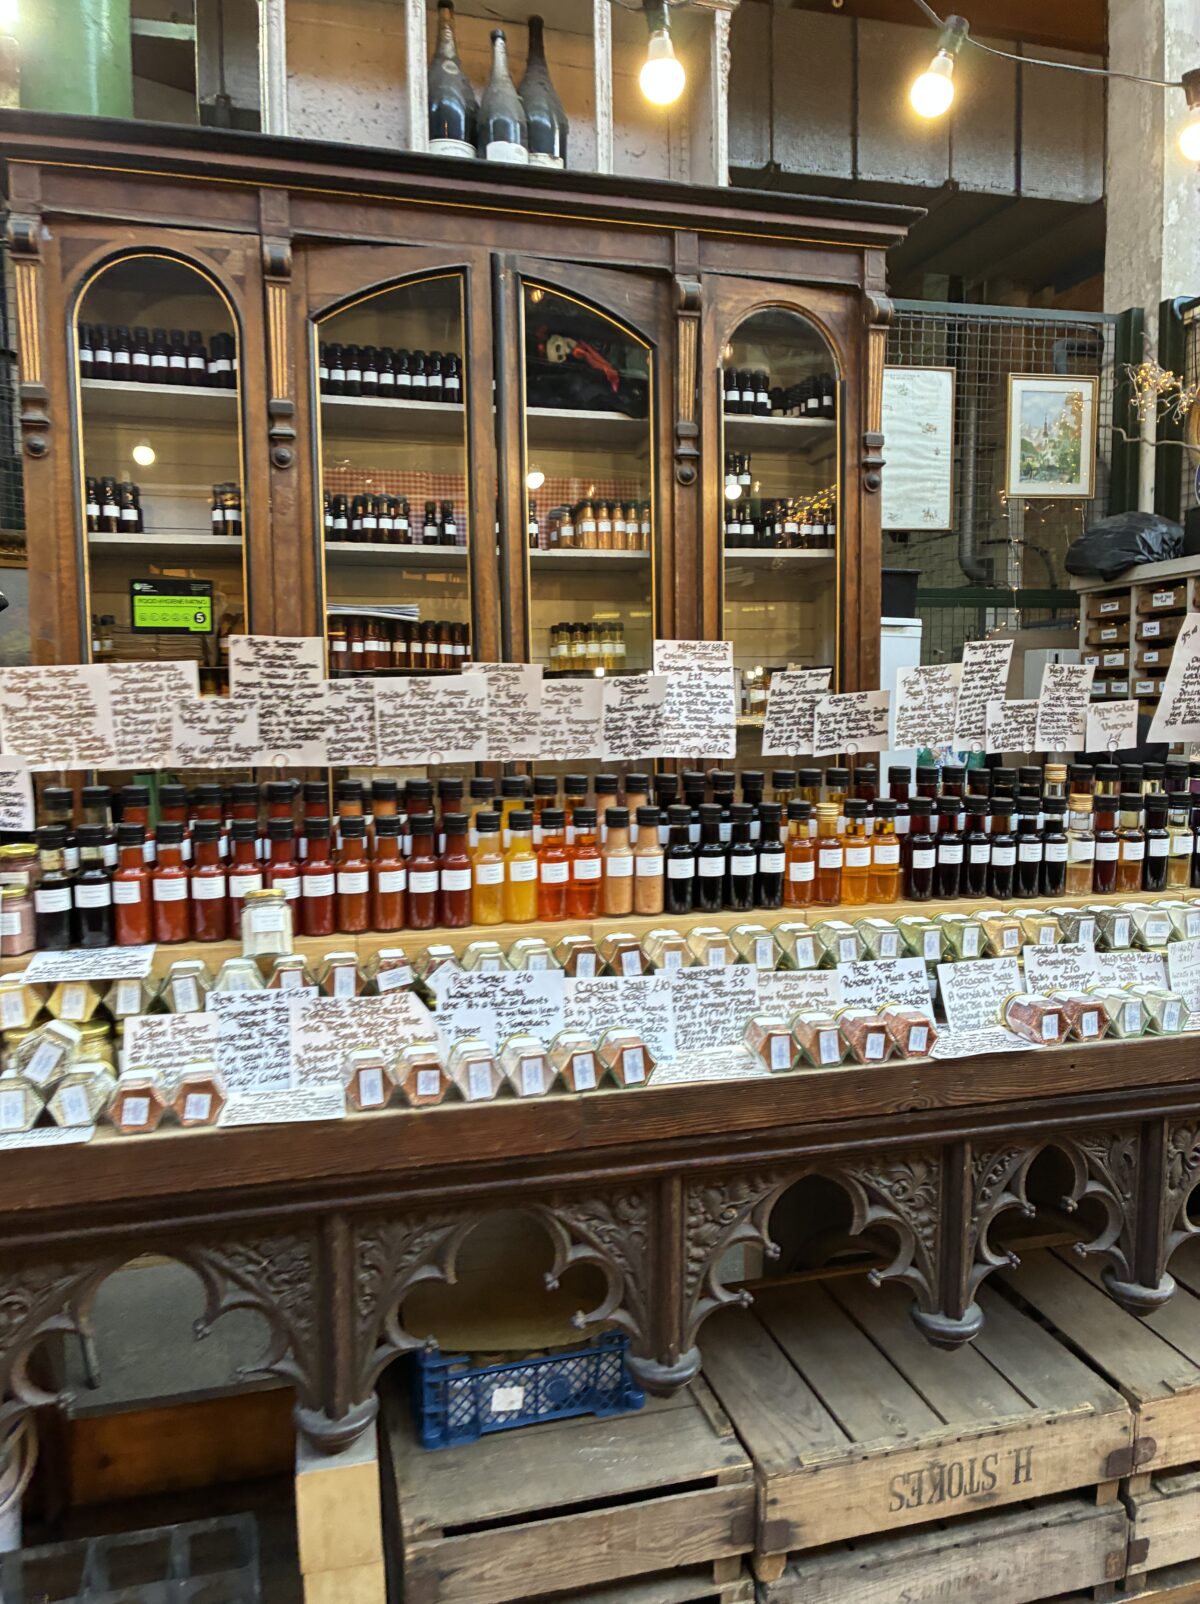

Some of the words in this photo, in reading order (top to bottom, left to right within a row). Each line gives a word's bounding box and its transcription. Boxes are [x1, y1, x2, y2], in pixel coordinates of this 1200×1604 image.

[196, 613, 205, 622] 5
[1064, 966, 1081, 974] £10
[888, 1452, 999, 1512] STOKES
